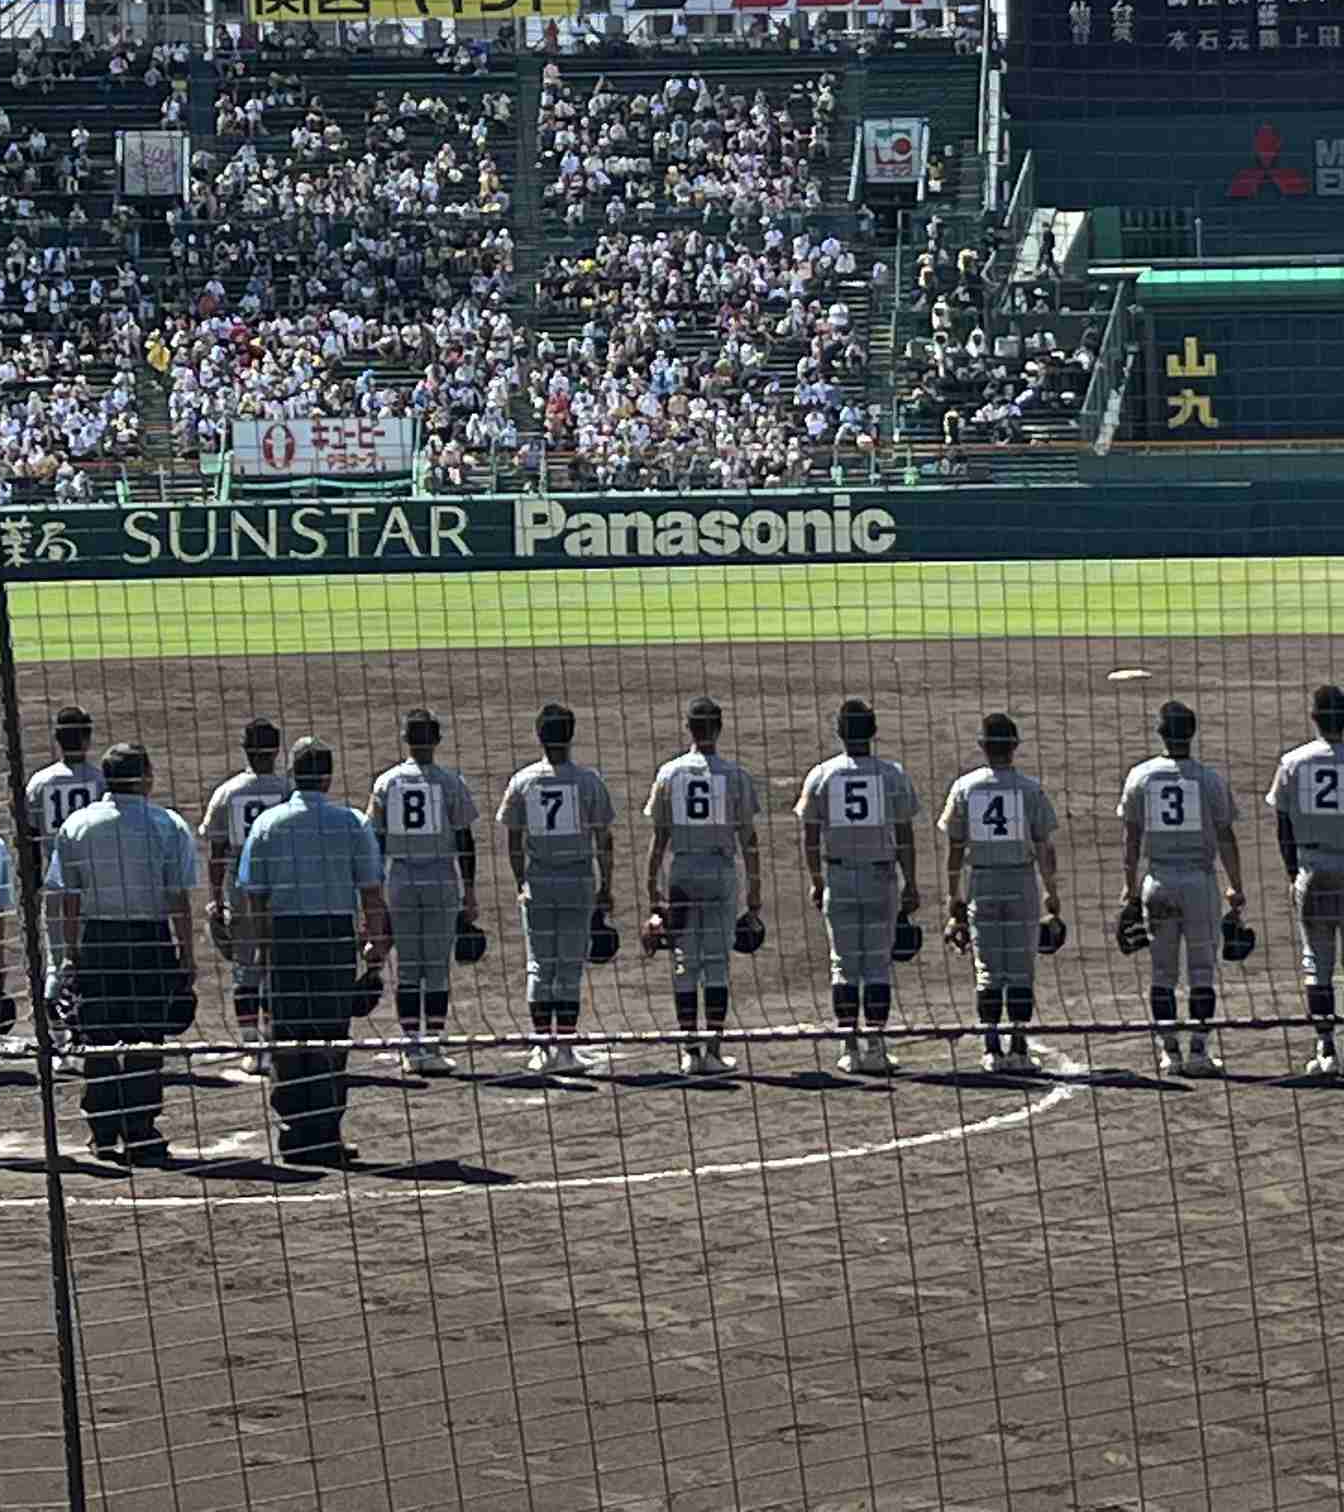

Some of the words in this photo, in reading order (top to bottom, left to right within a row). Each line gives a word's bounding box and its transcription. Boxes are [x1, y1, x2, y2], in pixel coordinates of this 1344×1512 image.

[122, 505, 471, 564] SUNSTAR
[514, 495, 898, 557] Panasonic
[687, 781, 709, 819] 6
[844, 782, 869, 821] 5
[1161, 786, 1184, 824] 3
[1315, 769, 1339, 809] 2
[402, 791, 426, 829] 8
[540, 791, 563, 829] 7
[983, 796, 1008, 835] 4
